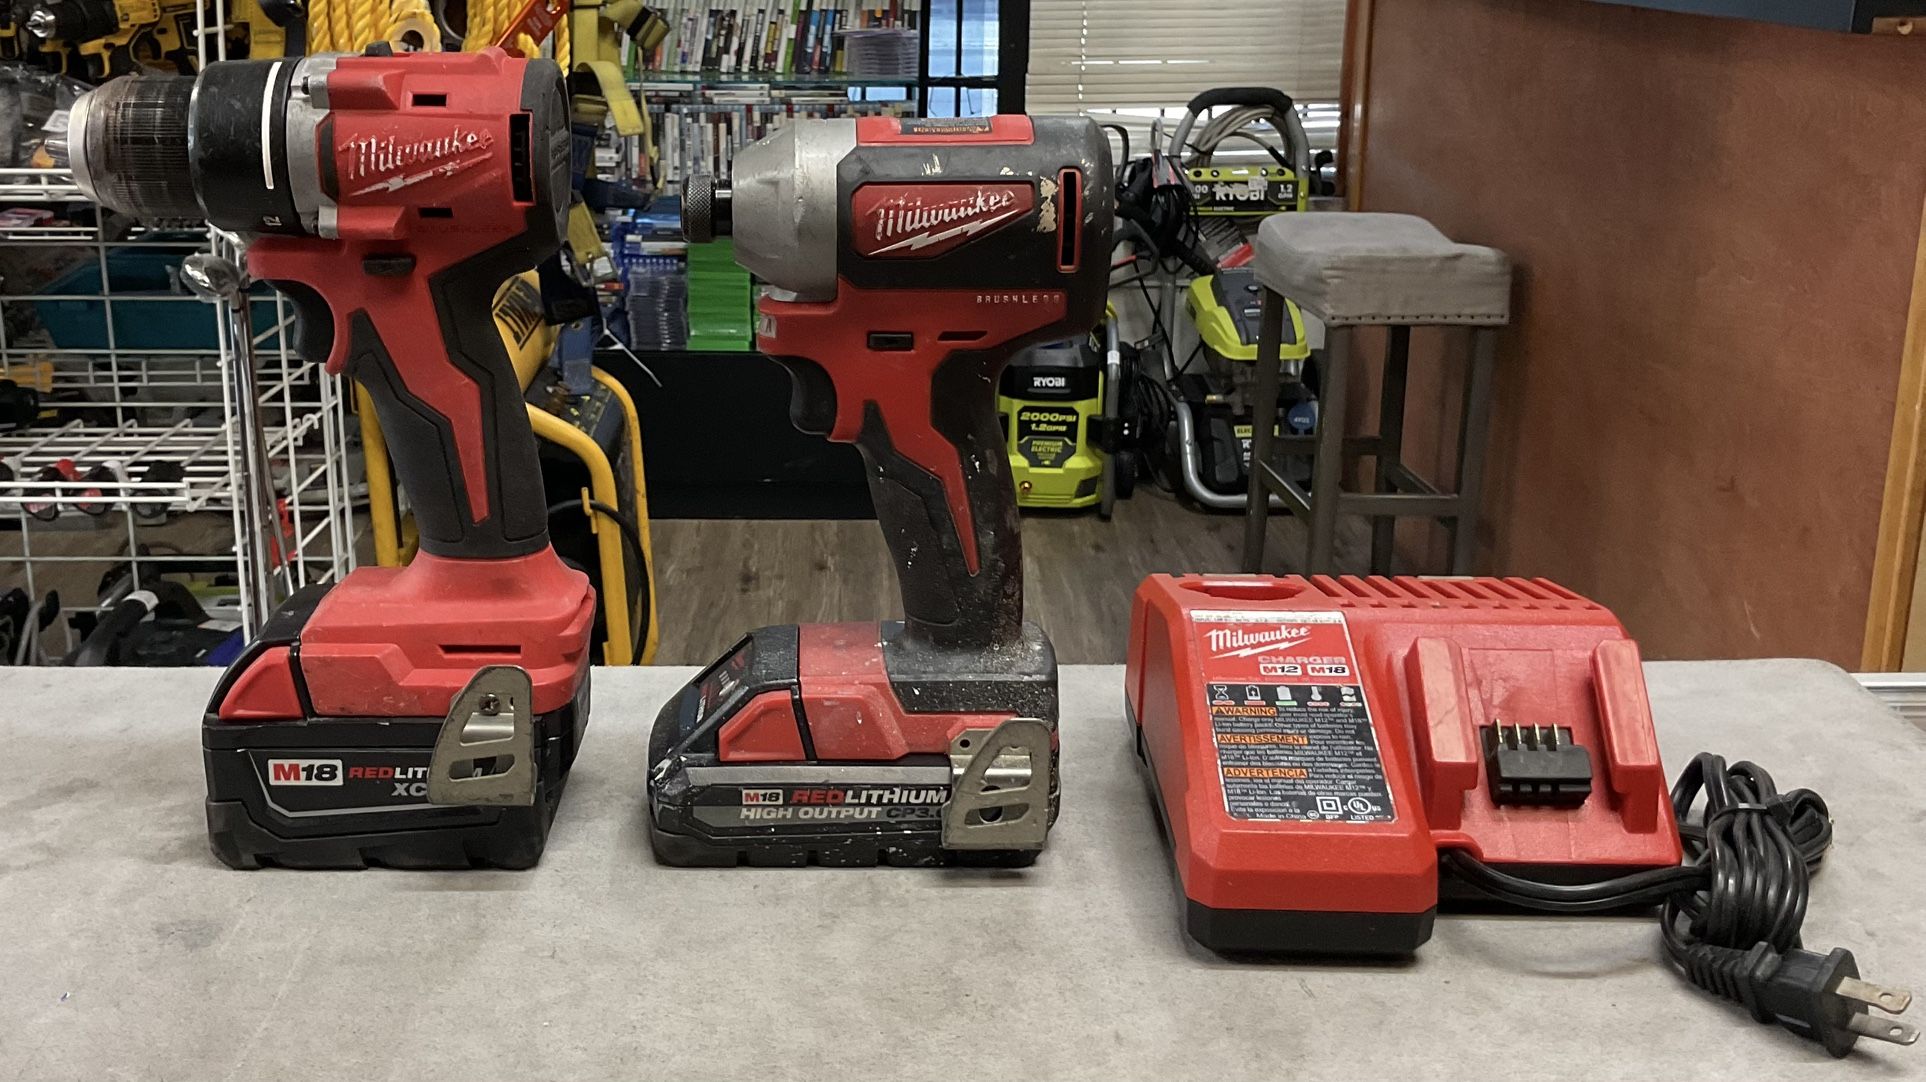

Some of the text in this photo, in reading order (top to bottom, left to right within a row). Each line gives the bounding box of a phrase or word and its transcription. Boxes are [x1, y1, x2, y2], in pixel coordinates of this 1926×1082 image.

[338, 124, 495, 180] Milwaukee
[864, 186, 1016, 241] Milwaukee
[1033, 377, 1066, 387] RYOBI
[1203, 625, 1312, 652] Milwaukee
[1257, 655, 1347, 664] CHARGER
[1261, 665, 1348, 675] M12 M18
[1224, 707, 1276, 715] WARNING
[1219, 735, 1305, 743] AVERTISSEMENT
[272, 762, 430, 782] M18 REDLIT
[1226, 768, 1307, 777] ADVERTENCIA
[743, 789, 948, 804] M18 REDLITHIUM
[740, 807, 793, 819] HIGH
[798, 807, 882, 819] OUTPUT
